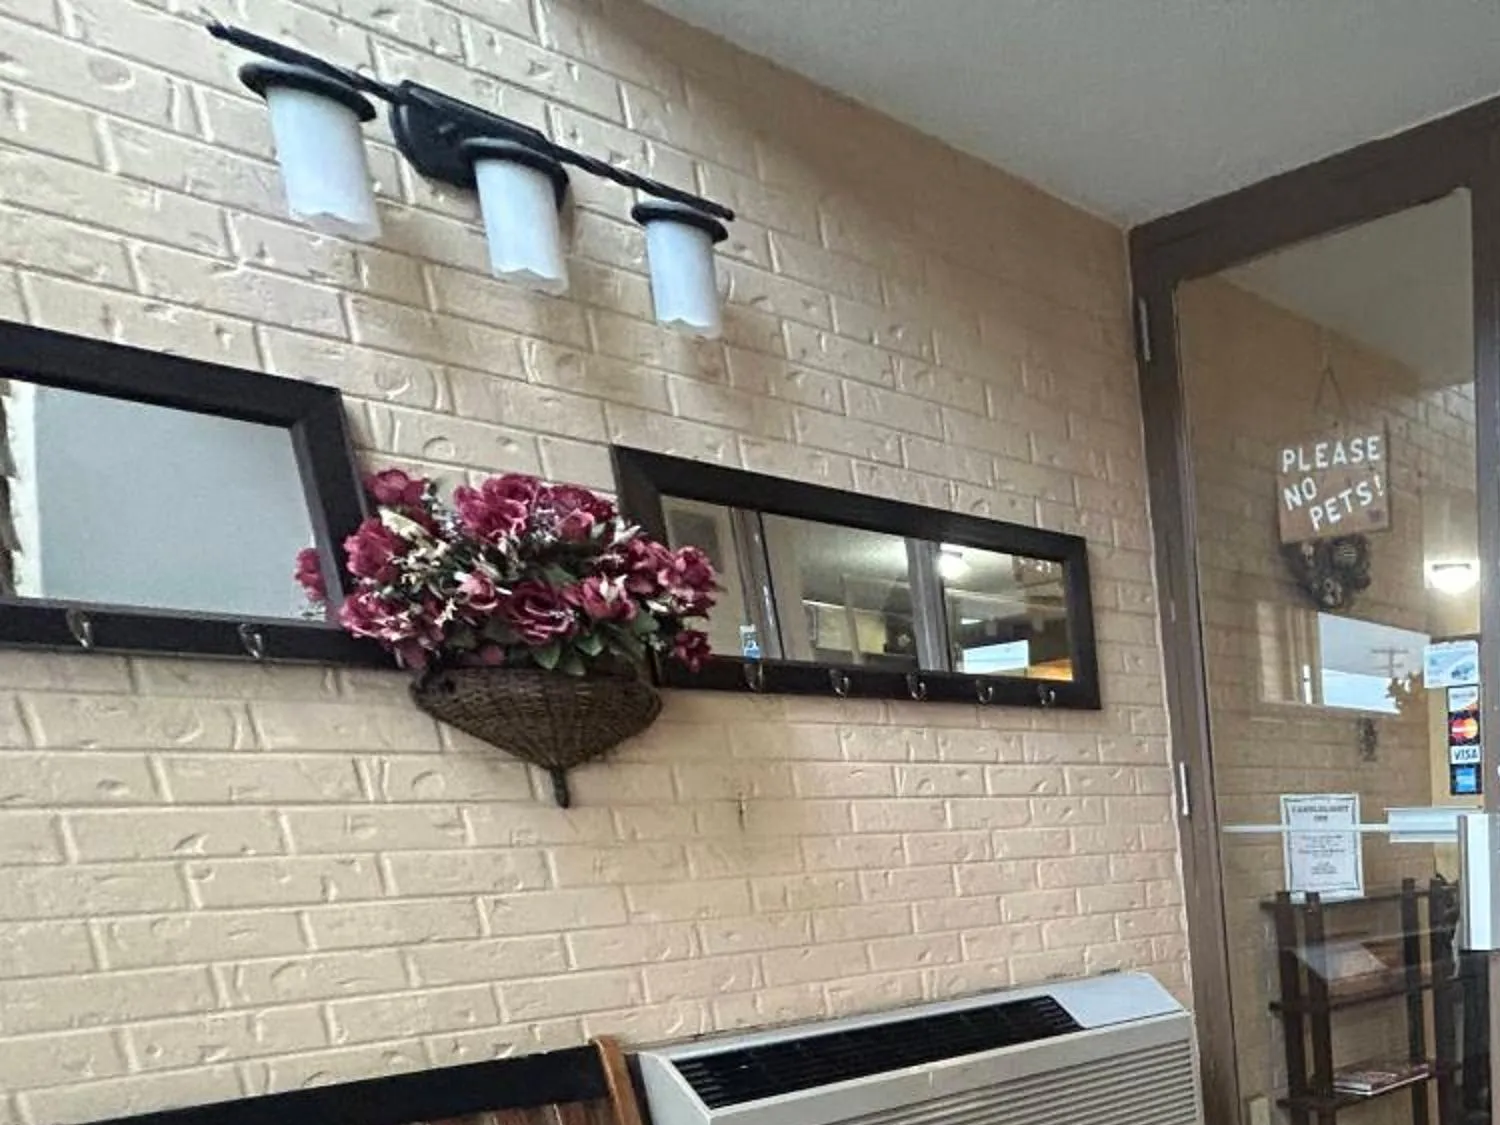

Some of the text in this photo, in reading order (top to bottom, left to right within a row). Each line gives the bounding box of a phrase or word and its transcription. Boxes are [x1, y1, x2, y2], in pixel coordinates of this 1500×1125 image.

[1282, 436, 1381, 473] PLEASE
[1283, 477, 1318, 511] NO
[1309, 474, 1384, 532] PETS!
[1454, 748, 1479, 760] VISA
